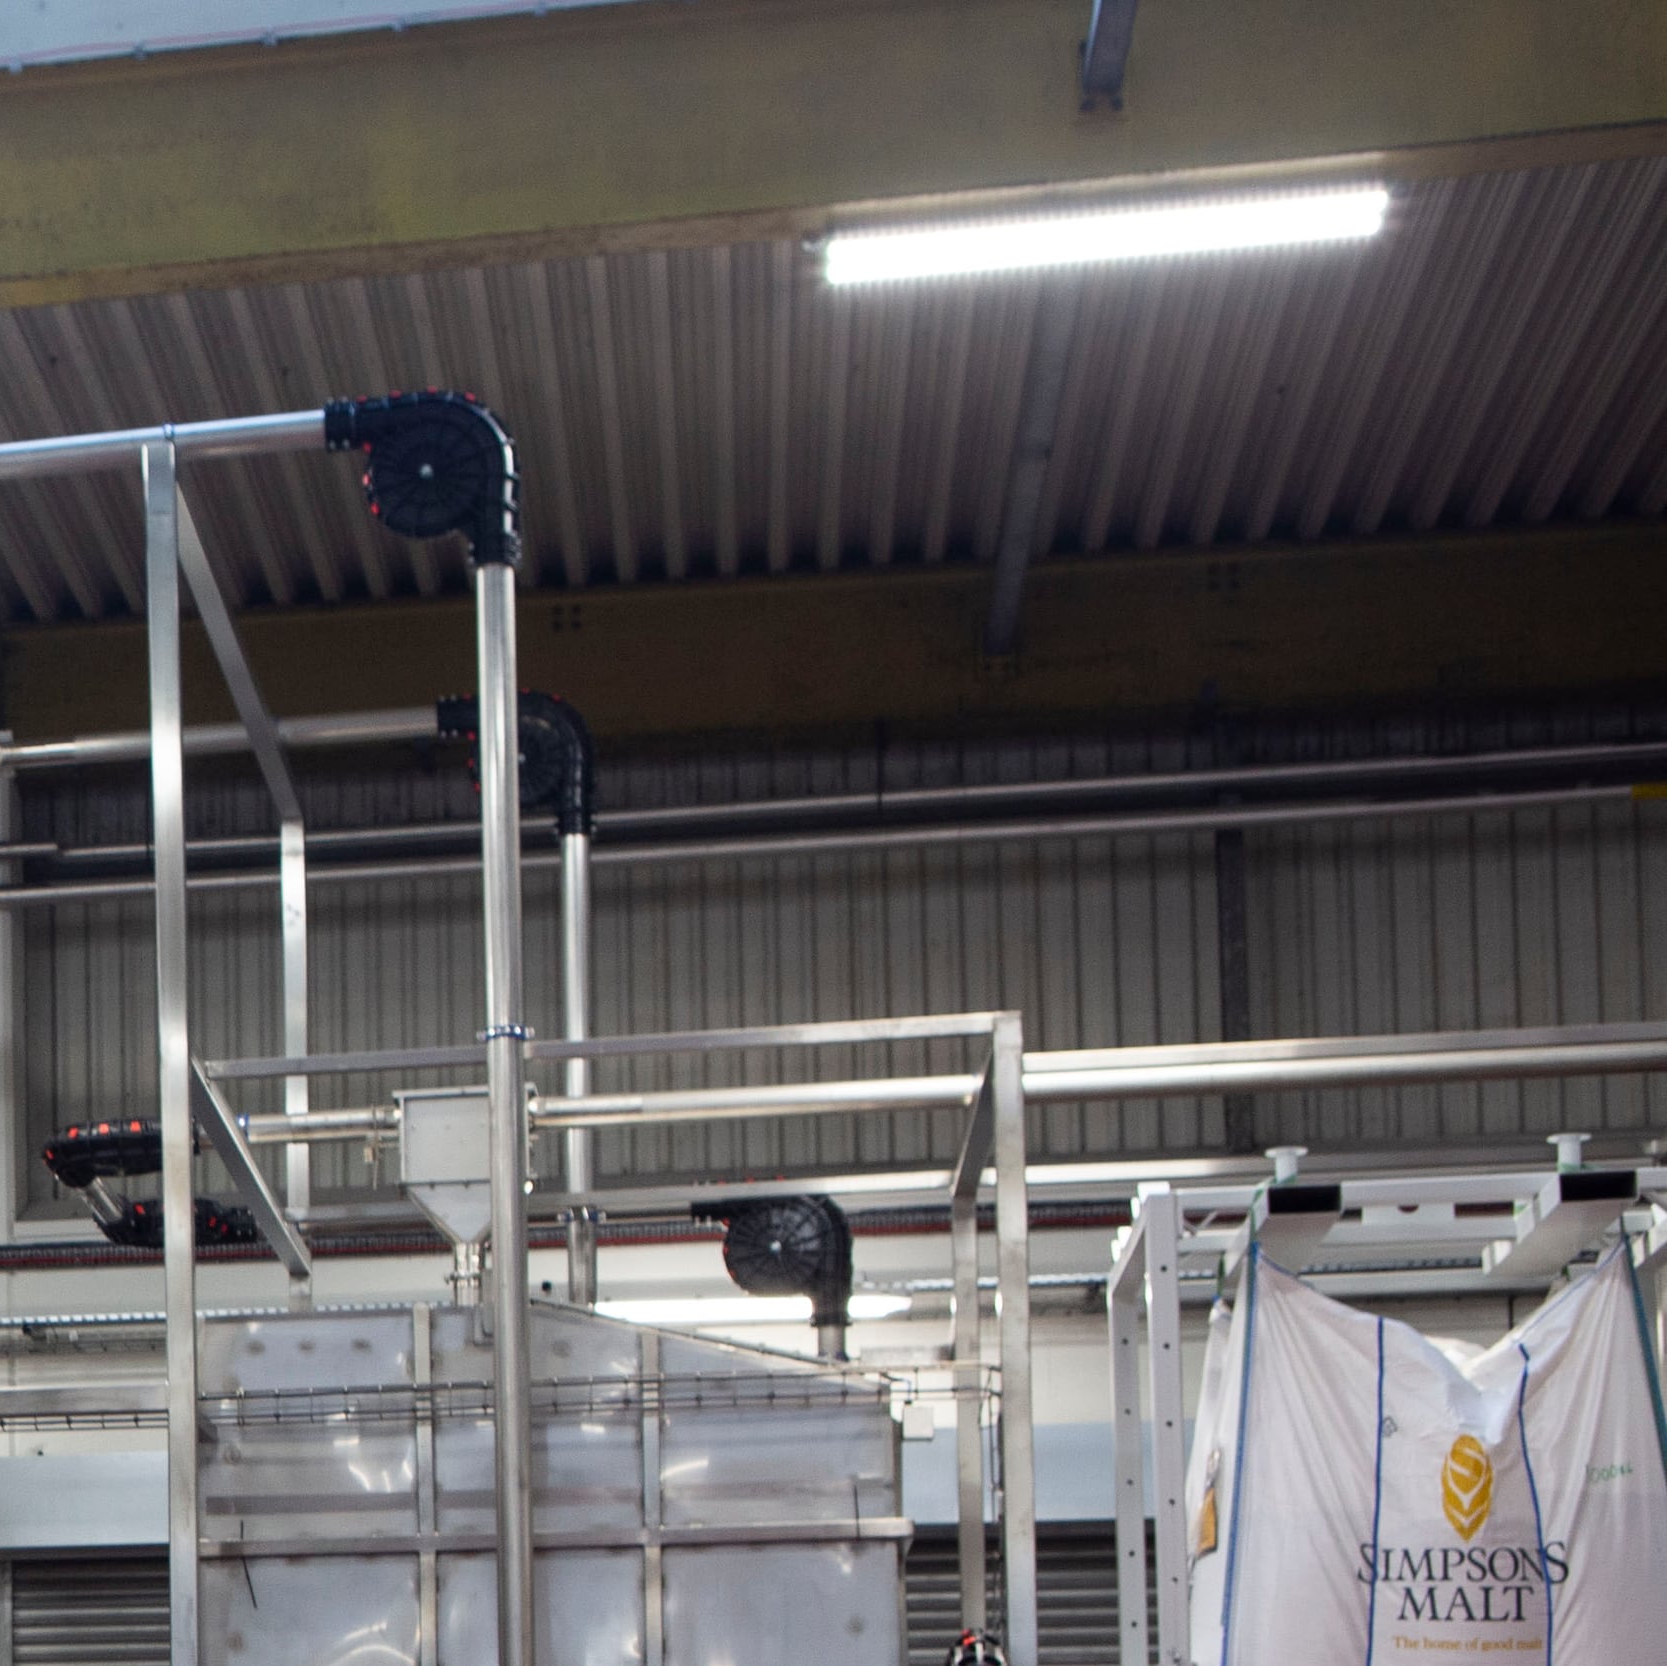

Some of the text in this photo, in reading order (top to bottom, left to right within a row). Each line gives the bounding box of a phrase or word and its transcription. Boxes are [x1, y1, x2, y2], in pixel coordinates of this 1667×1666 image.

[1357, 1541, 1570, 1585] SIMPSONS
[1397, 1586, 1535, 1623] MALT
[1393, 1636, 1420, 1650] The
[1424, 1636, 1461, 1651] home
[1465, 1636, 1479, 1651] of
[1481, 1637, 1514, 1653] good
